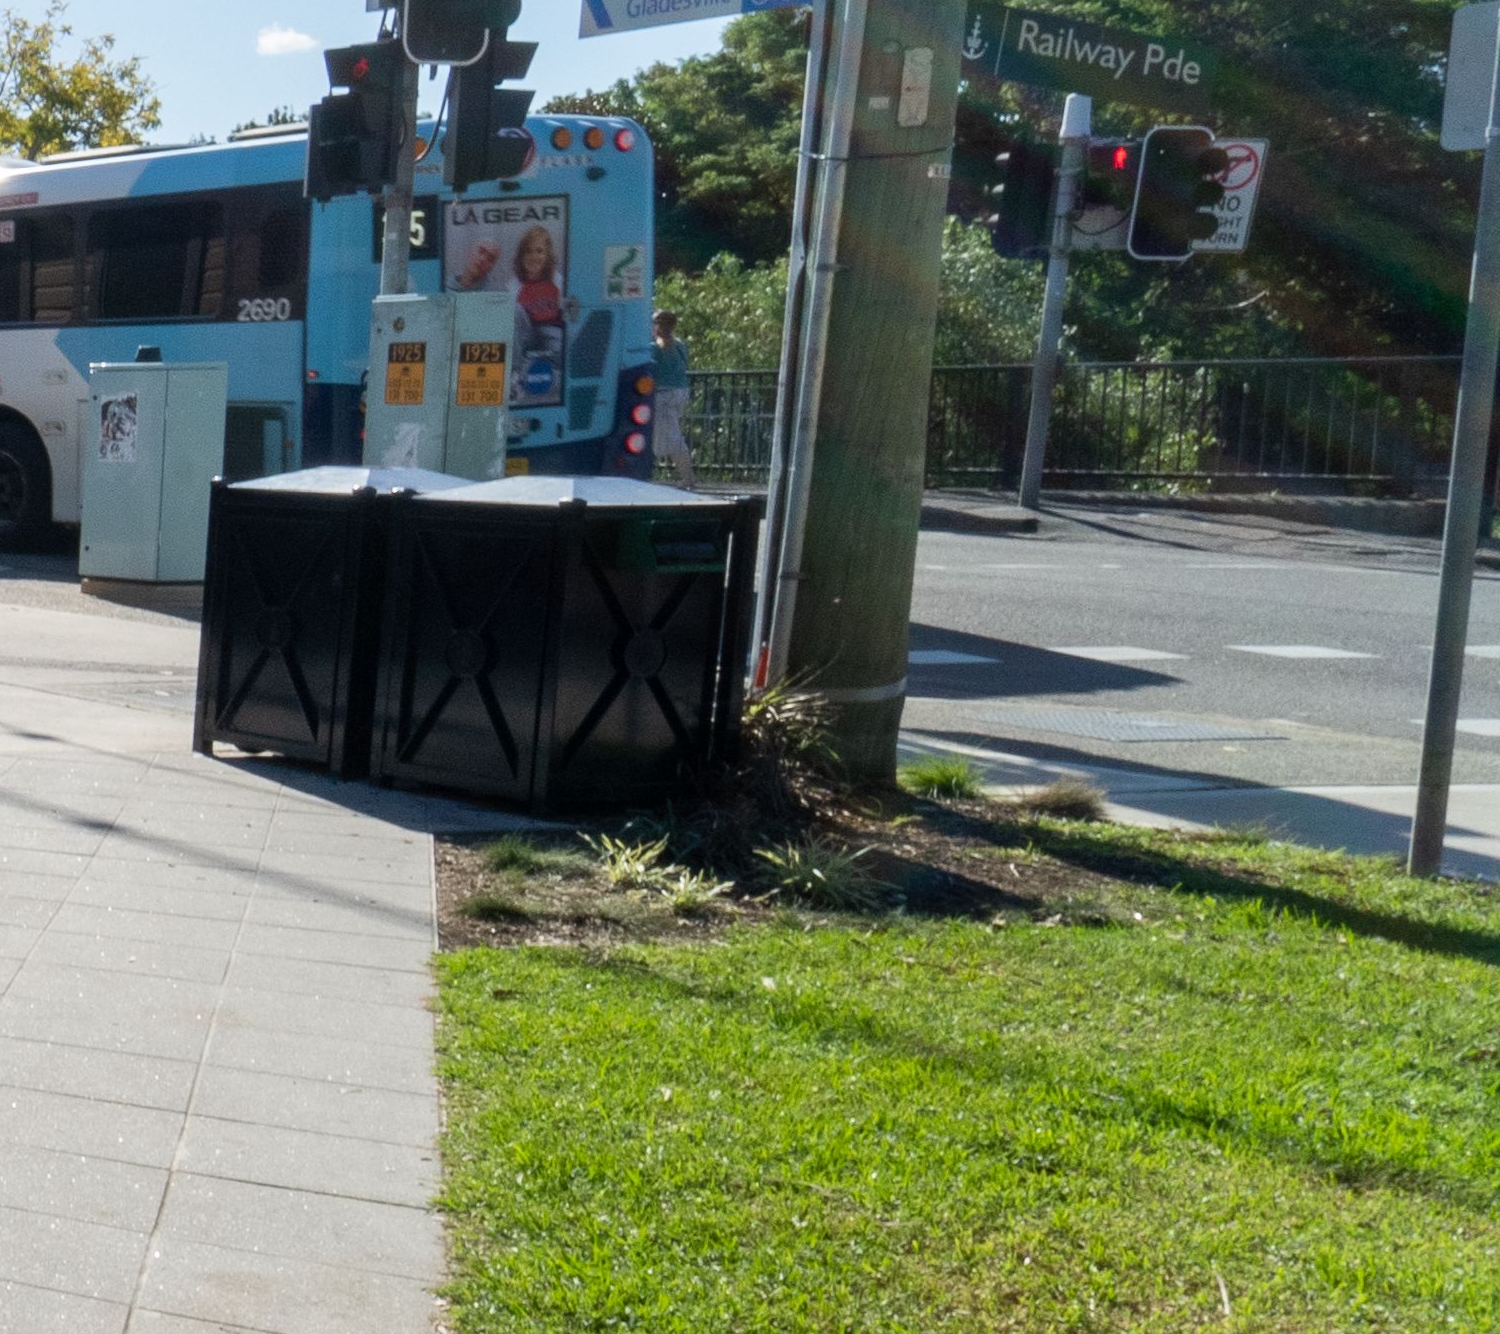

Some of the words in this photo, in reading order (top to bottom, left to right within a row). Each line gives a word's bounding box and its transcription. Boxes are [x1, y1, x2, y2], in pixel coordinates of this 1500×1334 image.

[1017, 19, 1136, 80] Railway
[1143, 43, 1202, 85] Pde
[452, 207, 479, 226] LA
[483, 205, 560, 224] GEAR
[237, 297, 291, 322] 2690
[392, 344, 421, 362] 1925
[465, 344, 500, 362] 1925
